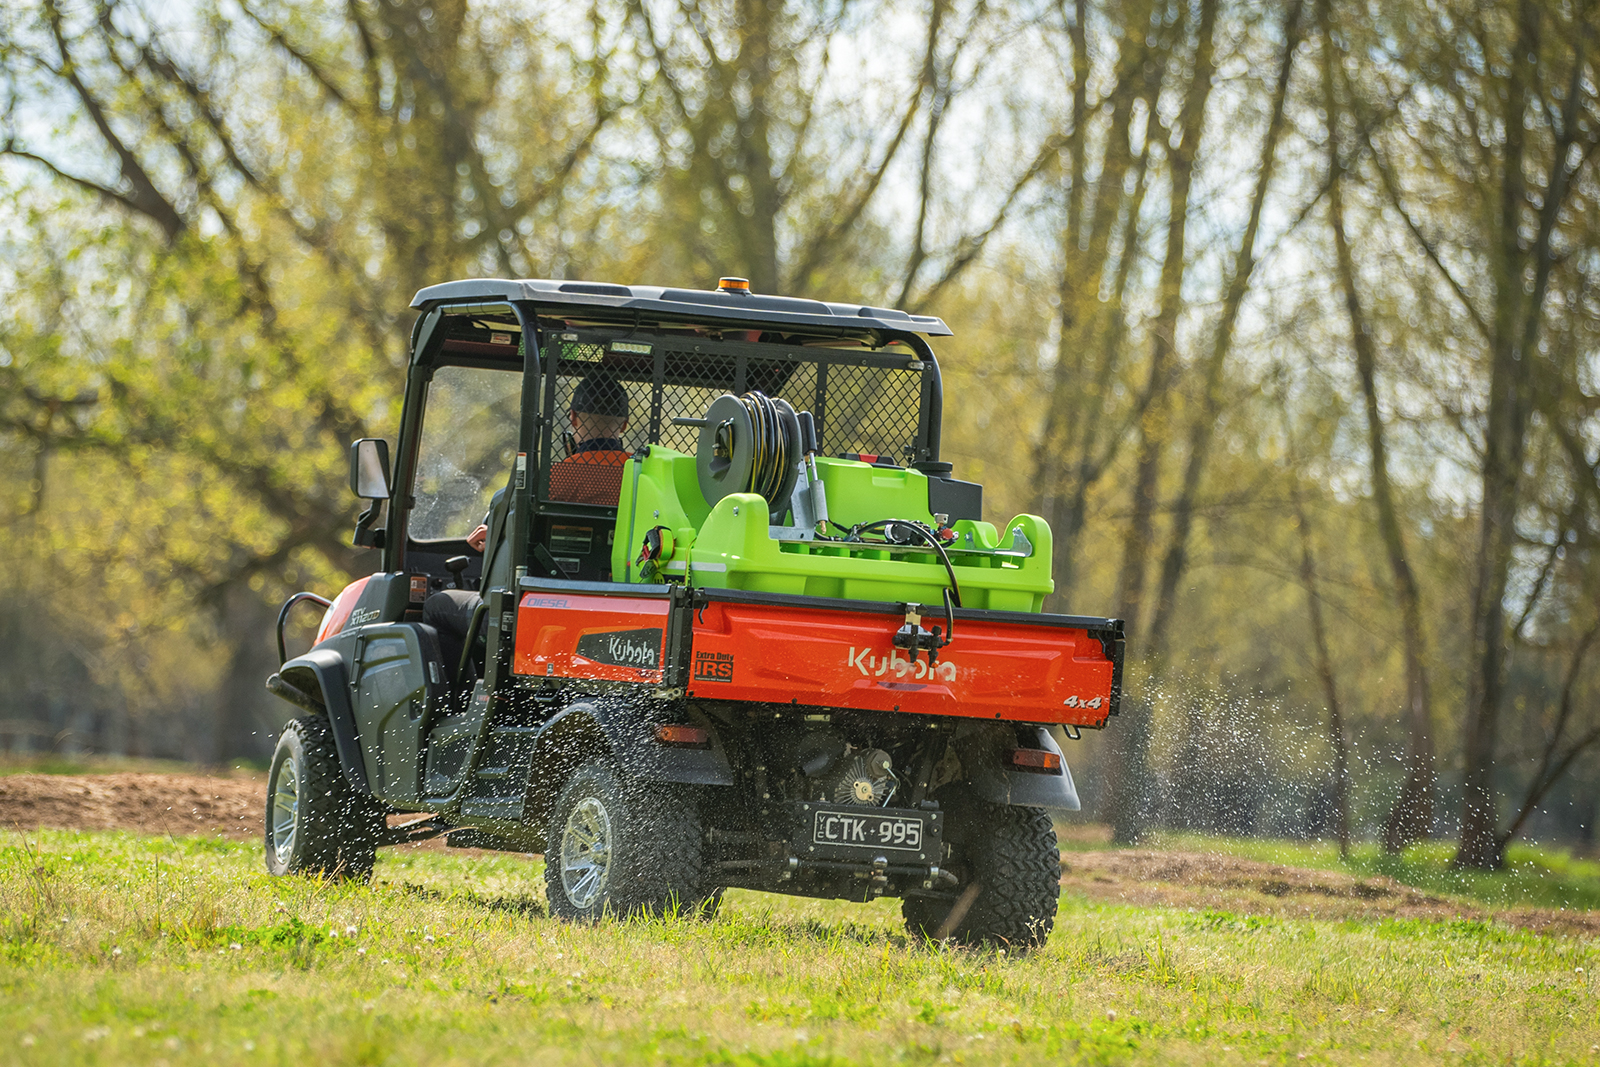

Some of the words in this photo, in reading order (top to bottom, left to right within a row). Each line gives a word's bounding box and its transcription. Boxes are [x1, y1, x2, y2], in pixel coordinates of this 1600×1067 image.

[526, 597, 571, 609] DIESEL
[608, 637, 655, 665] Kubota
[696, 650, 715, 660] Extra
[716, 652, 734, 662] Duty
[695, 660, 732, 677] IRS
[1063, 695, 1102, 709] 4x4
[817, 816, 826, 839] VIC
[825, 817, 867, 842] CTK
[878, 821, 920, 846] 995
